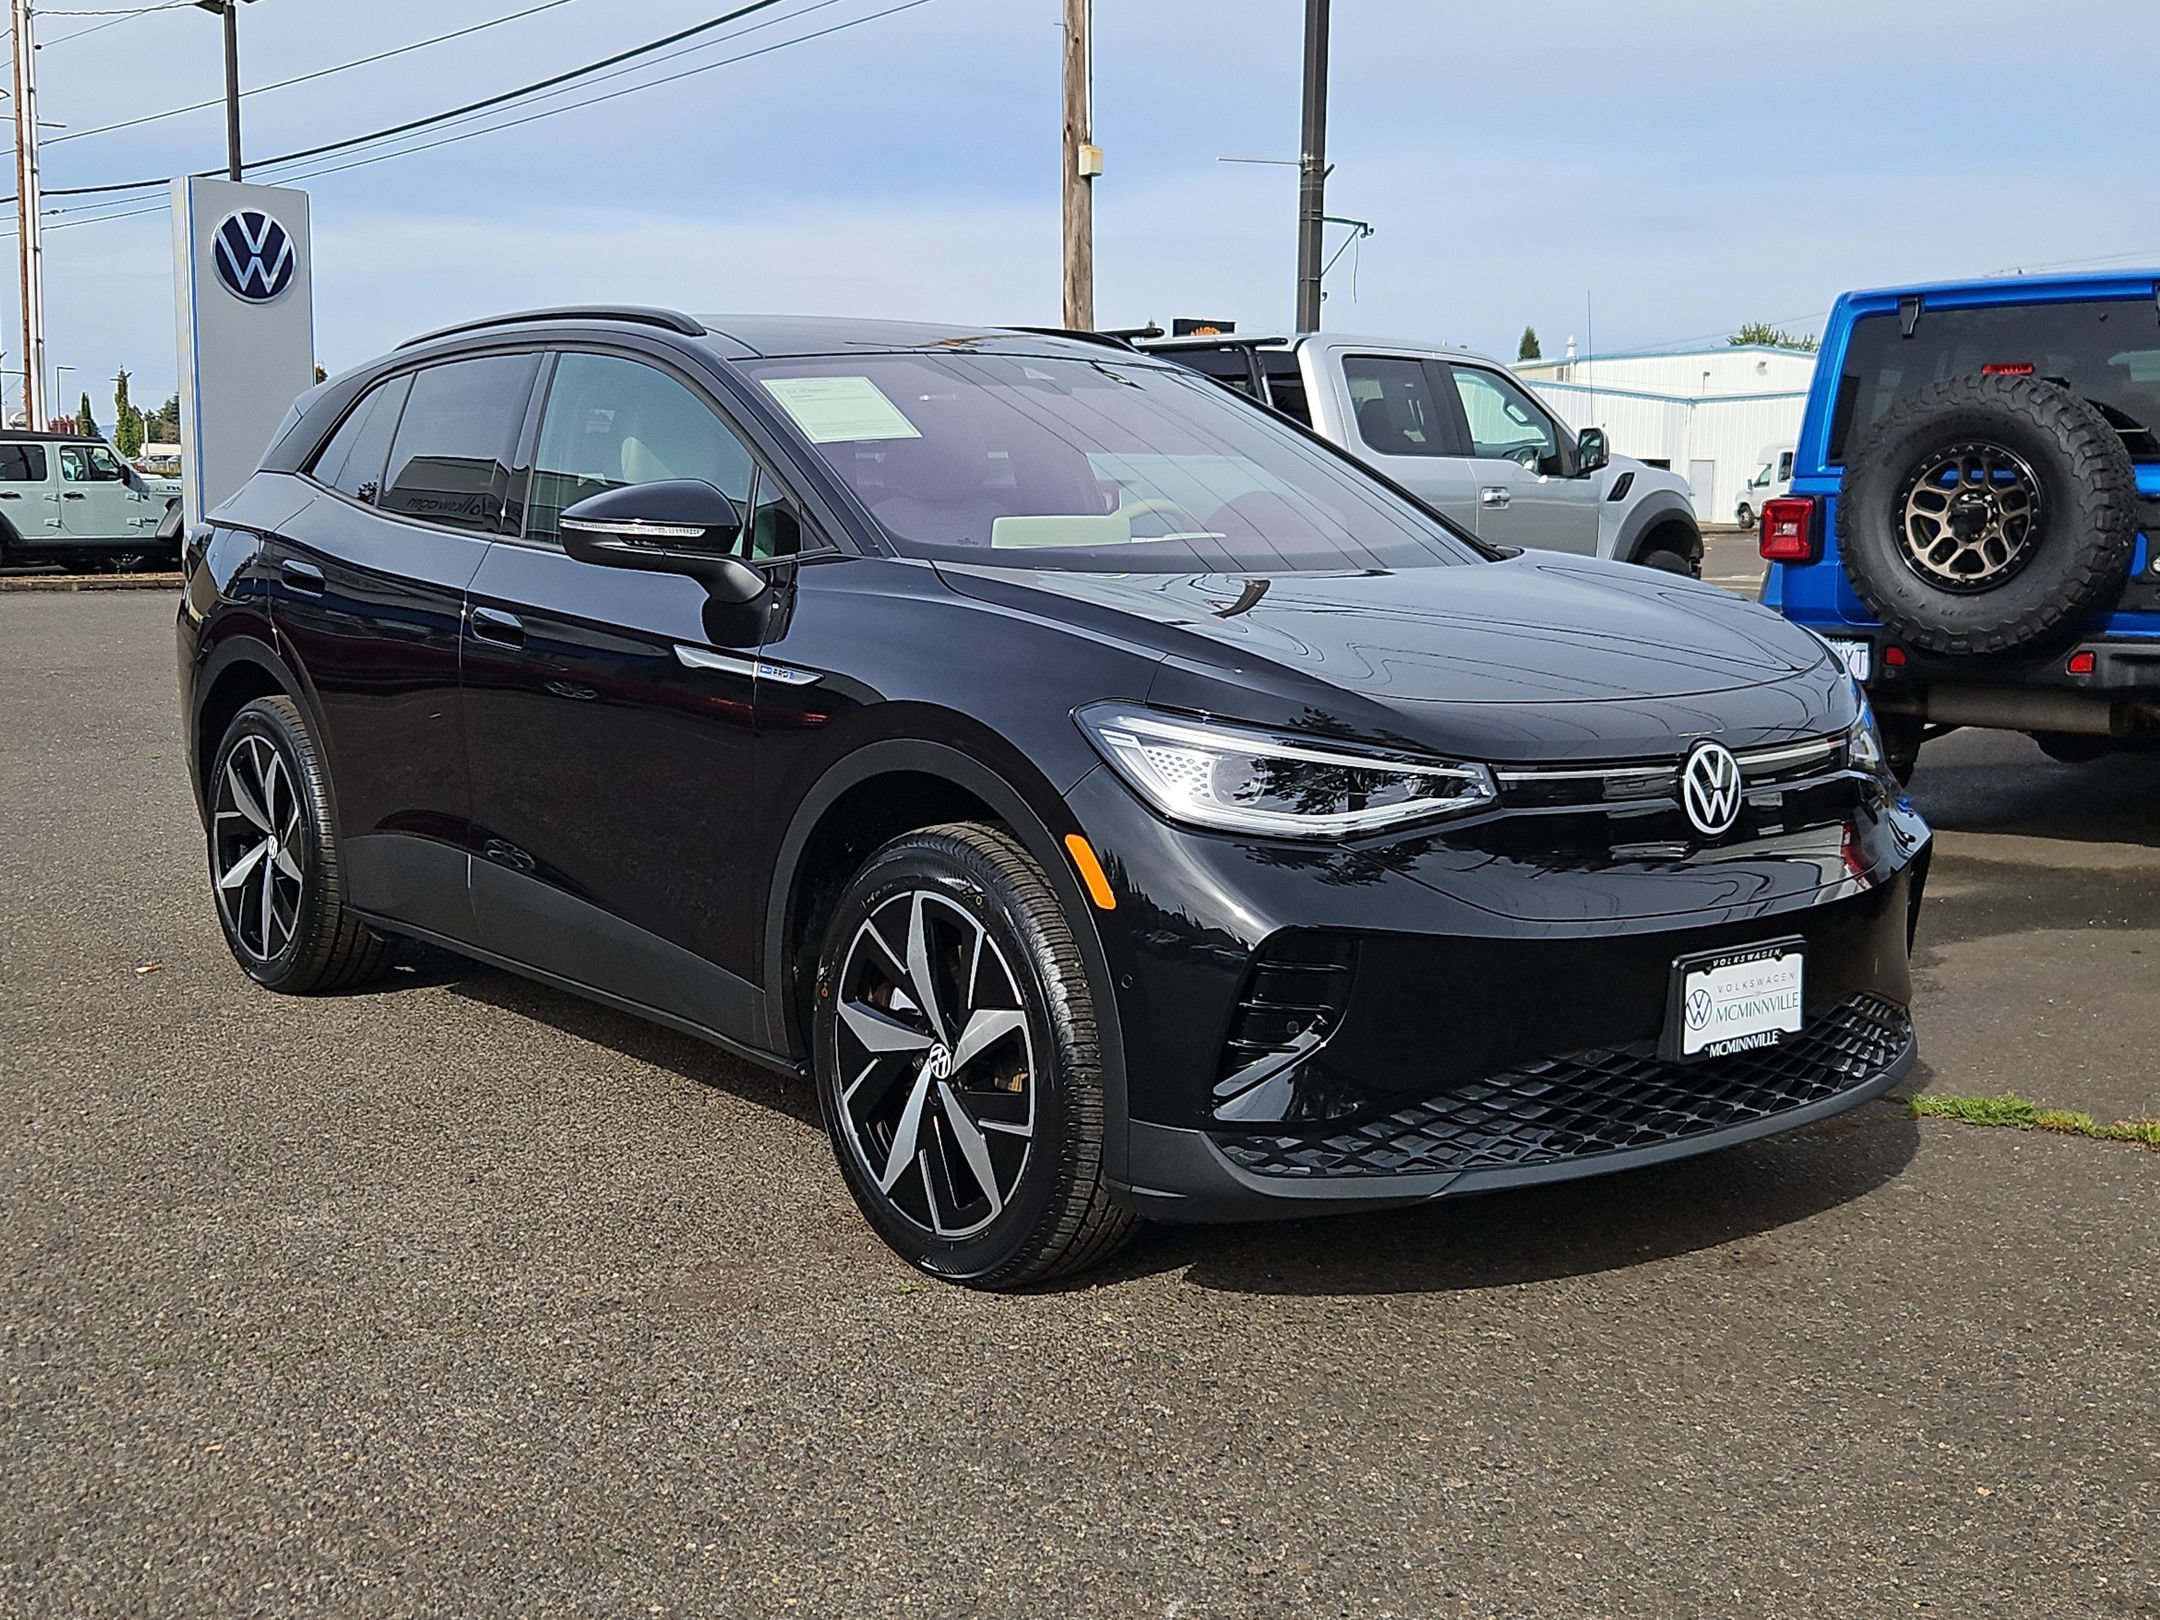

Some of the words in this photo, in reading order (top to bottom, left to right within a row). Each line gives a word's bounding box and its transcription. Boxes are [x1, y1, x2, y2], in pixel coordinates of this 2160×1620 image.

[1713, 948, 1781, 967] VOLKSWAGEN
[1717, 972, 1795, 993] VOLKSWAGEN
[1715, 992, 1799, 1023] MCMINNVILLE
[1709, 1030, 1779, 1058] MCMINNVILLE
